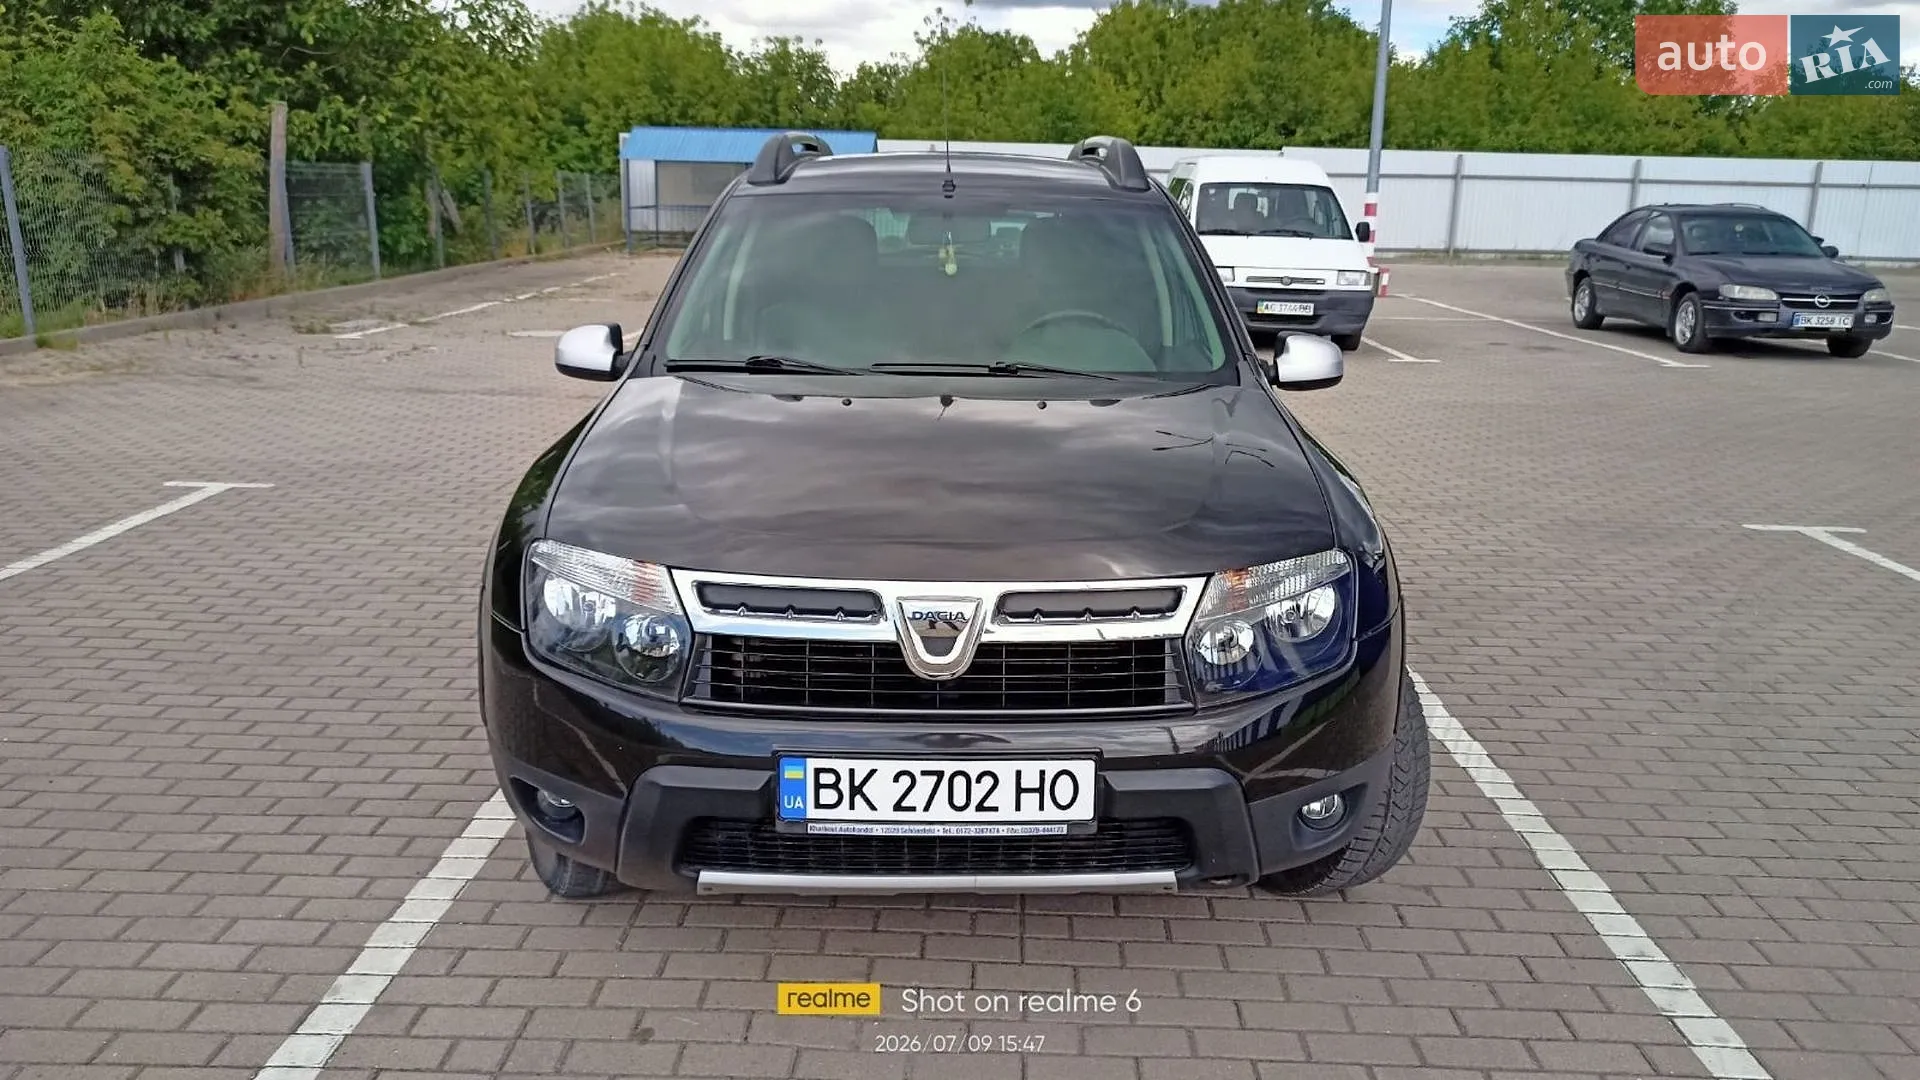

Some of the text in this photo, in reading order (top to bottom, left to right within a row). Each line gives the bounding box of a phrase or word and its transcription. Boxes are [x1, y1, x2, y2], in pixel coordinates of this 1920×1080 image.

[911, 611, 967, 621] DACIA
[813, 767, 1080, 812] BK 2702 HO
[784, 795, 804, 809] UA
